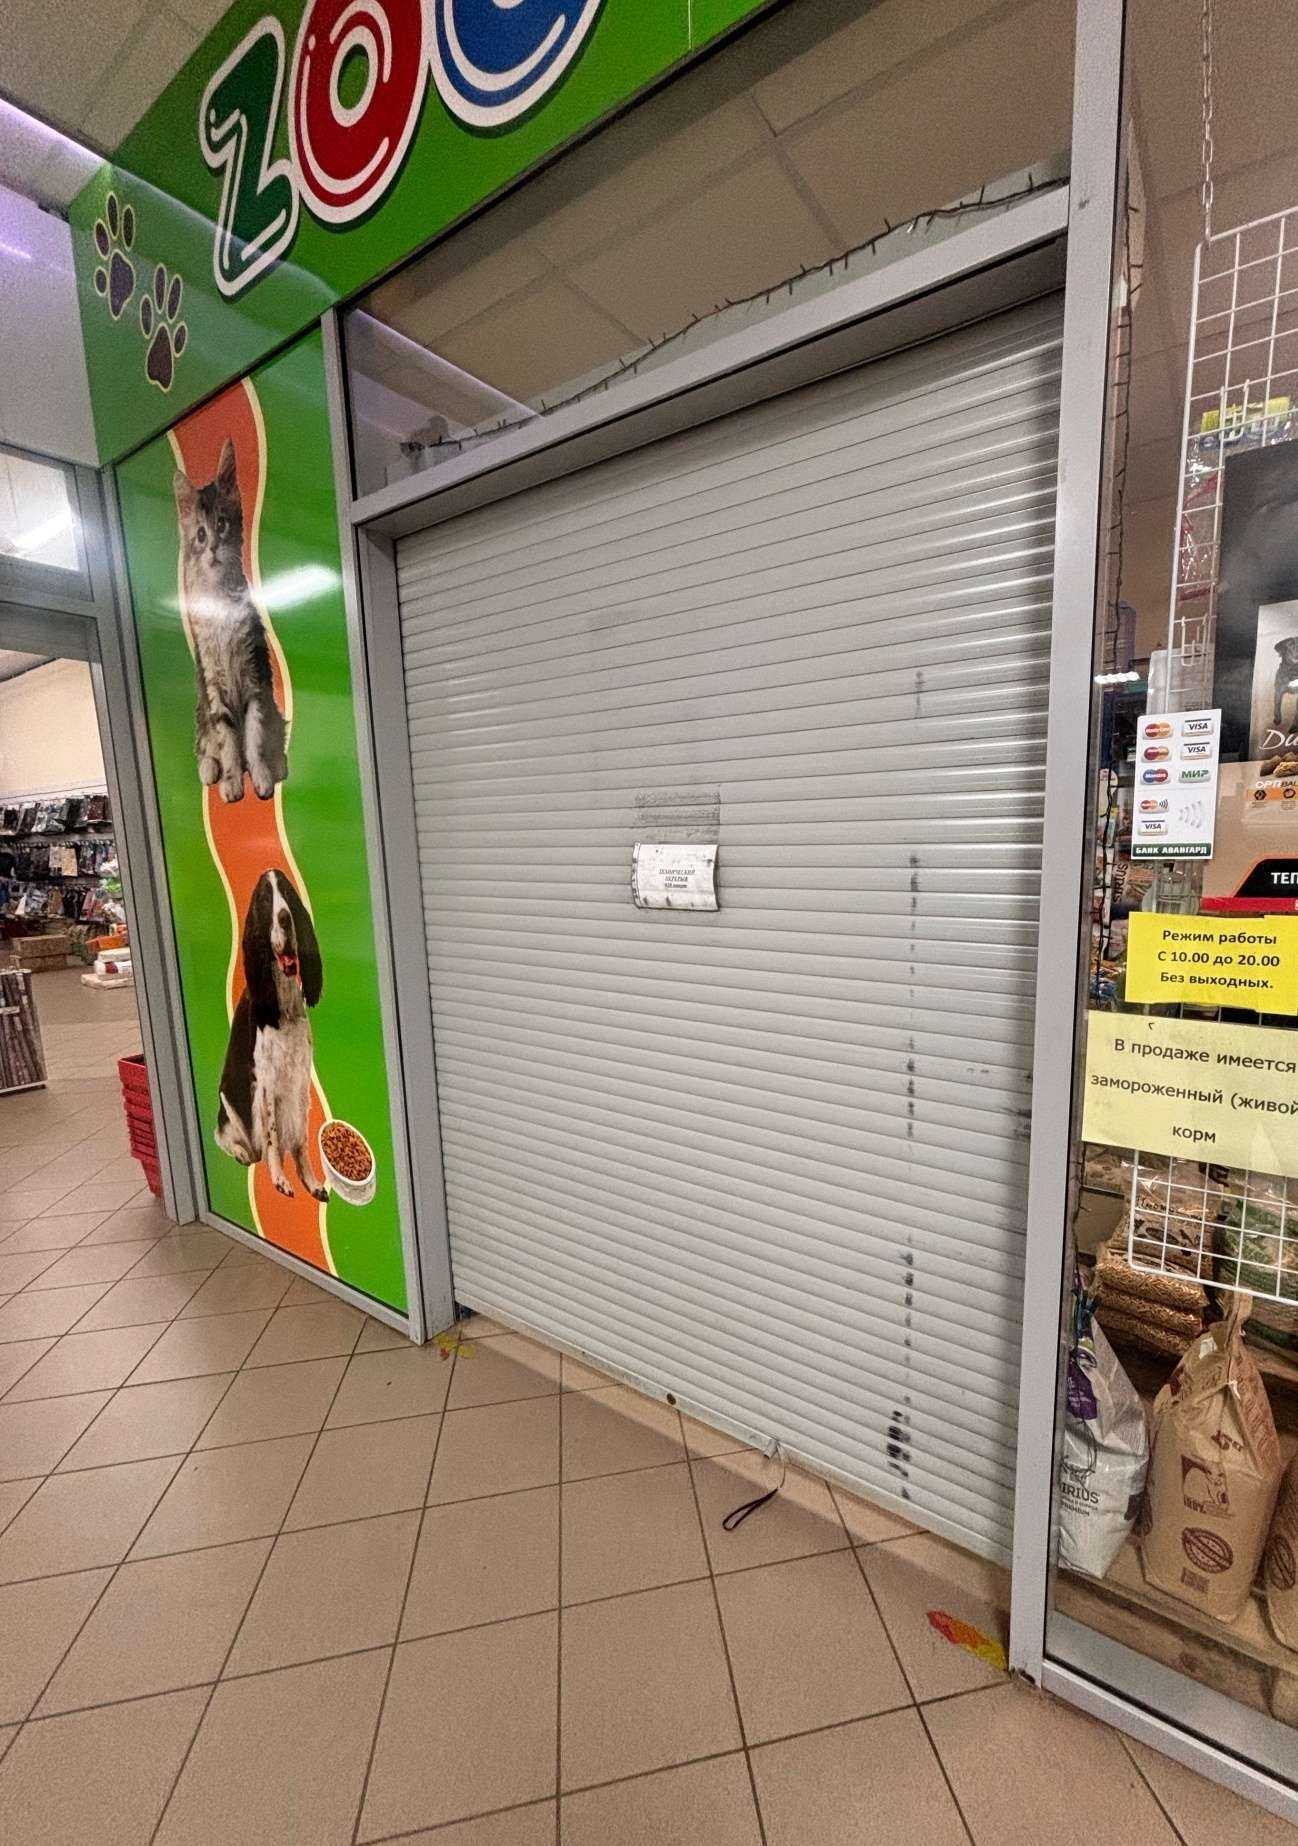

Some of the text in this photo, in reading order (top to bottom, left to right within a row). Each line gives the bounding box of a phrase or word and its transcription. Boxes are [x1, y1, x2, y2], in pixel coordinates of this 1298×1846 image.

[1188, 722, 1208, 731] VISA
[1181, 769, 1209, 779] МИР
[1162, 930, 1277, 945] Режим работы
[1158, 951, 1280, 967] С 10.00 до 20.00
[1160, 972, 1273, 988] Без выходных.
[1114, 1039, 1297, 1074] В продаже имеется
[1091, 1075, 1298, 1116] замороженный (живой
[1172, 1125, 1217, 1143] корм
